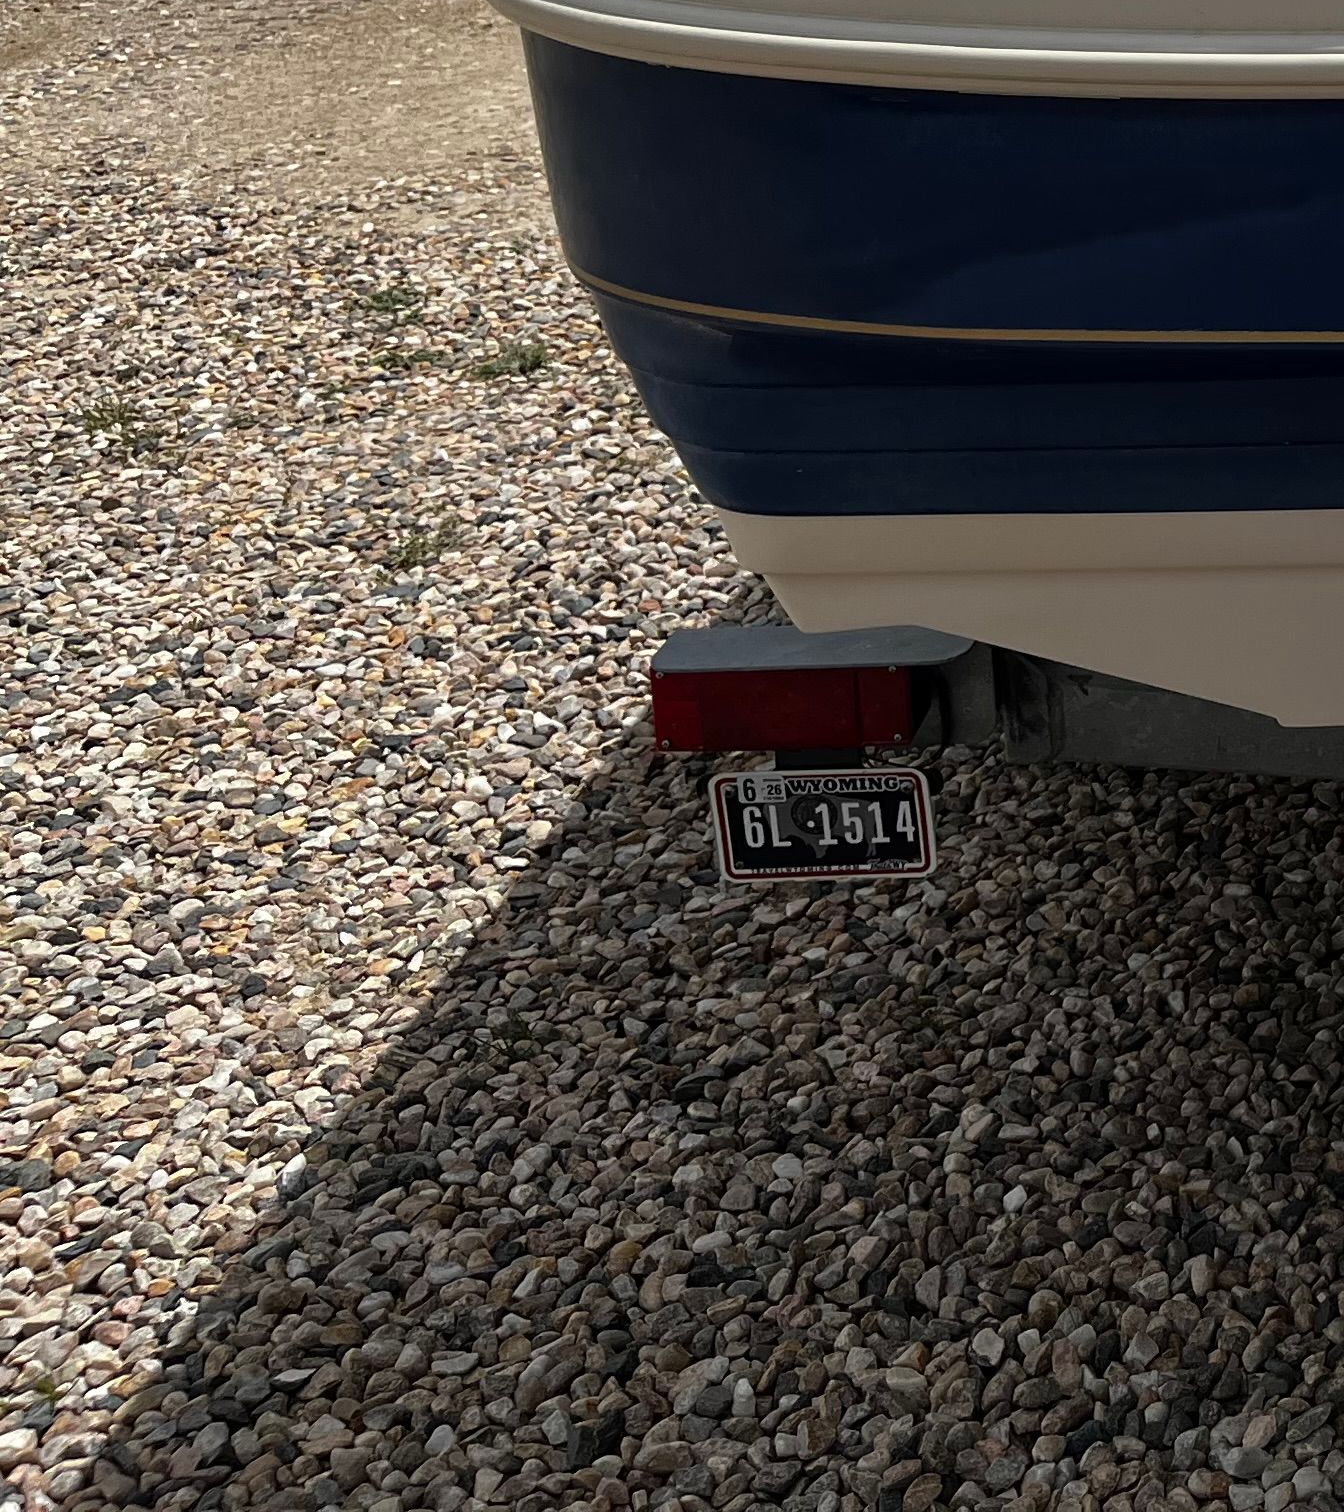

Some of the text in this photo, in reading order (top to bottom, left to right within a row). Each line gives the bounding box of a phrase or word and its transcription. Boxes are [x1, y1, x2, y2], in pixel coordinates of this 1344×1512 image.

[742, 776, 900, 802] 6 26 WYOMING
[742, 800, 916, 849] 6L 1514
